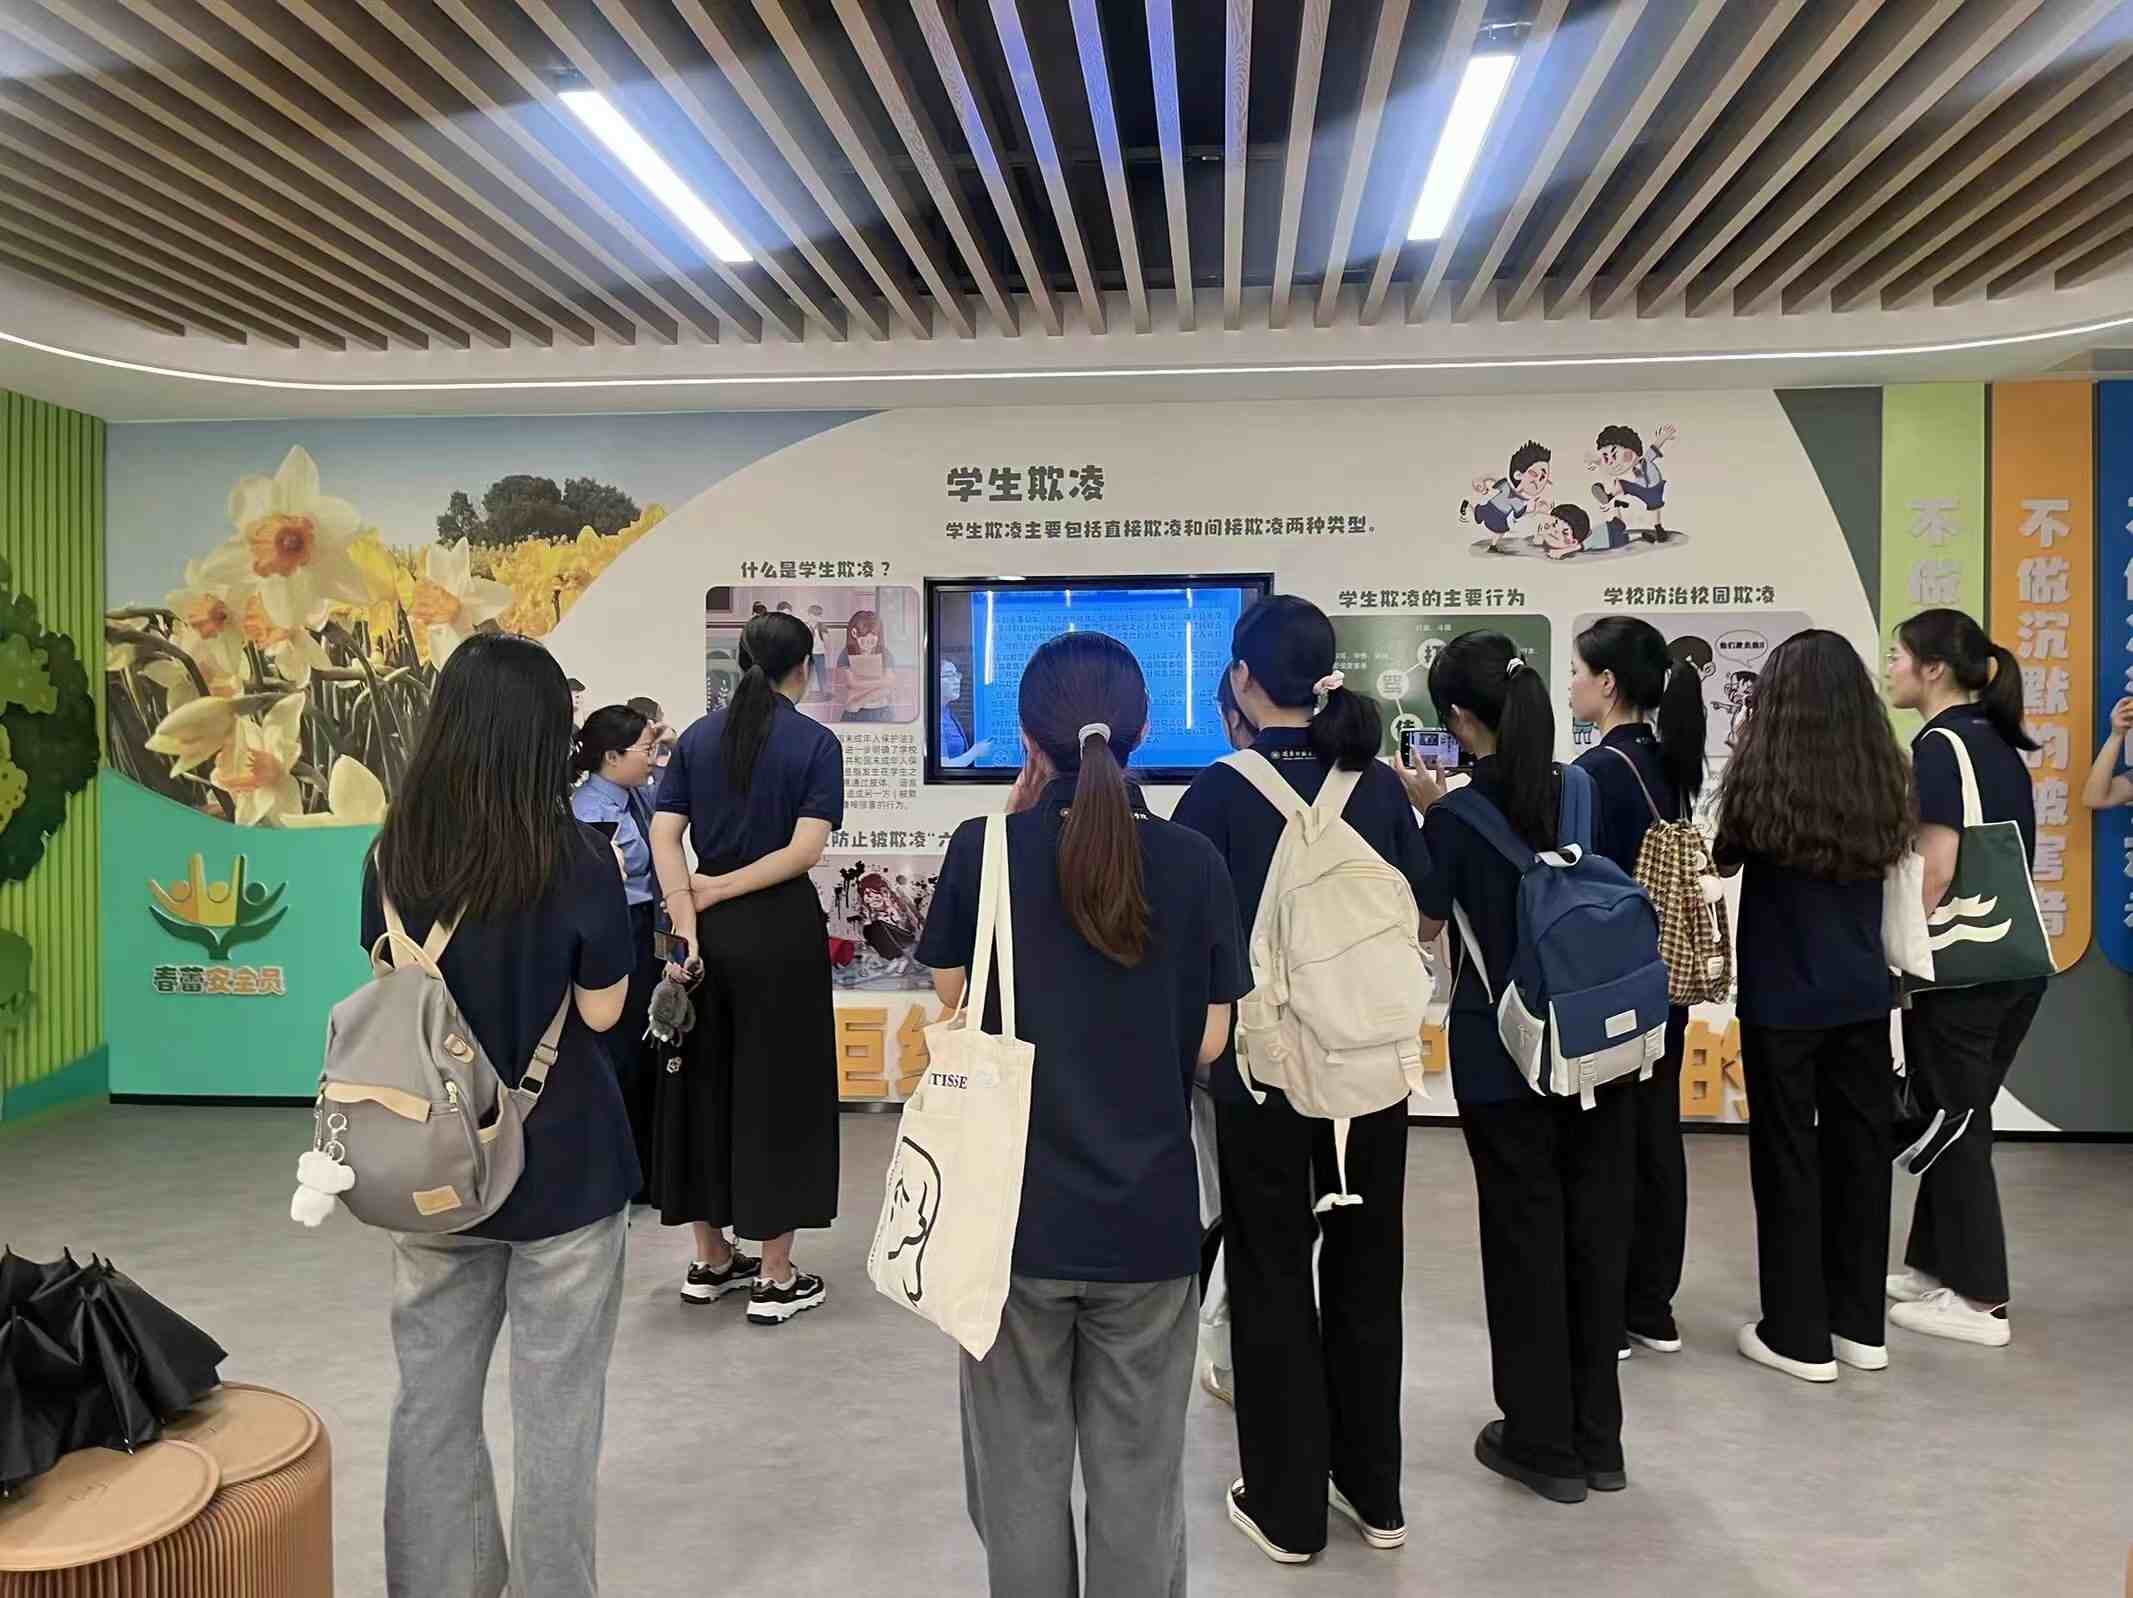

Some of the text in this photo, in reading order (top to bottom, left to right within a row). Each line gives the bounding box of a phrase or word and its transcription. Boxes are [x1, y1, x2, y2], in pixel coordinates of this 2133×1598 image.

[947, 465, 1105, 502] 学生欺凌
[946, 516, 1376, 540] 学生欺凌主要包括直接欺凌和间接欺凌两种类型。
[741, 561, 891, 578] 什么是学生欺凌？
[1339, 588, 1525, 608] 学生欺凌的主要行为
[1604, 585, 1775, 605] 学校防治校园欺凌
[154, 966, 283, 993] 春蕾安全员
